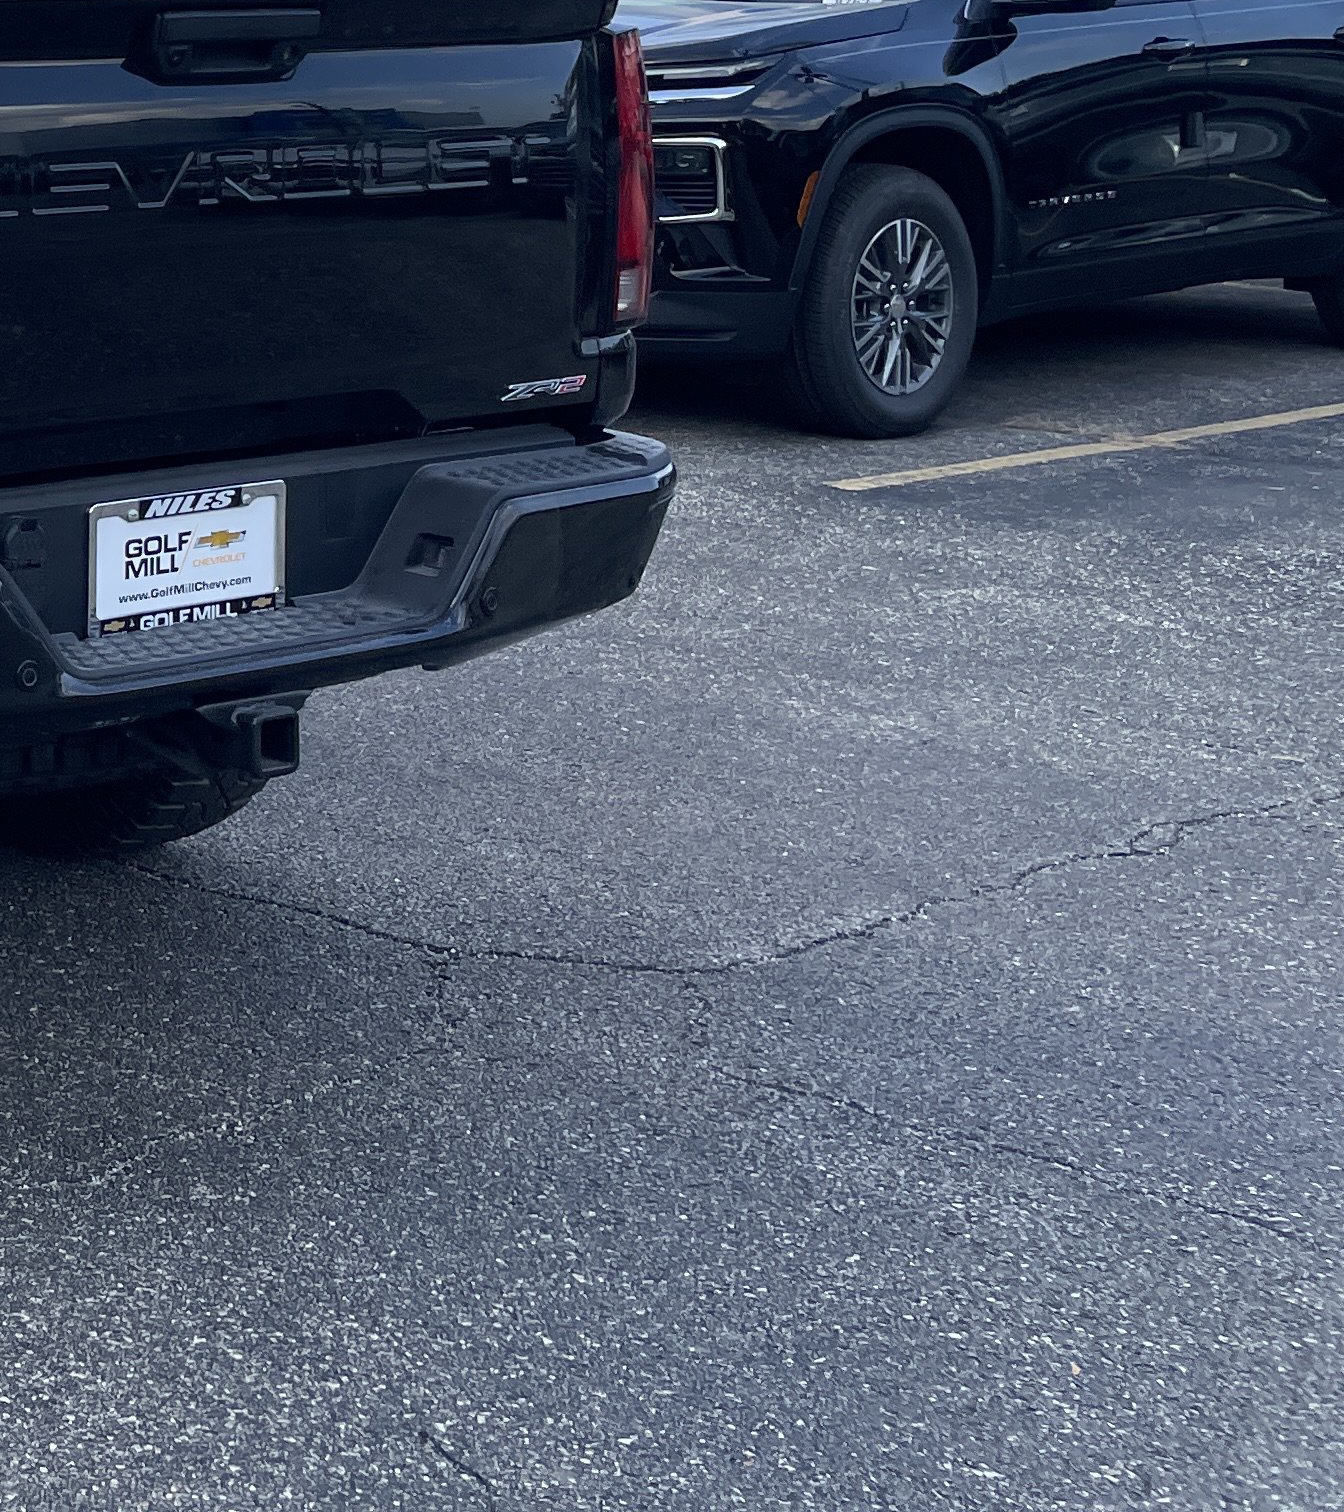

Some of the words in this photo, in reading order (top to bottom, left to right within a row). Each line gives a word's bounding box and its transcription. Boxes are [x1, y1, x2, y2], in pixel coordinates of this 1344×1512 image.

[500, 375, 587, 402] ZR2
[144, 489, 236, 519] NILES
[124, 530, 192, 559] GOLF
[124, 554, 180, 580] MILL
[192, 552, 247, 568] CHEVROLET
[118, 575, 252, 604] www.GolfMillChevy.com
[139, 608, 192, 631] GOLF
[192, 602, 238, 622] MILL
